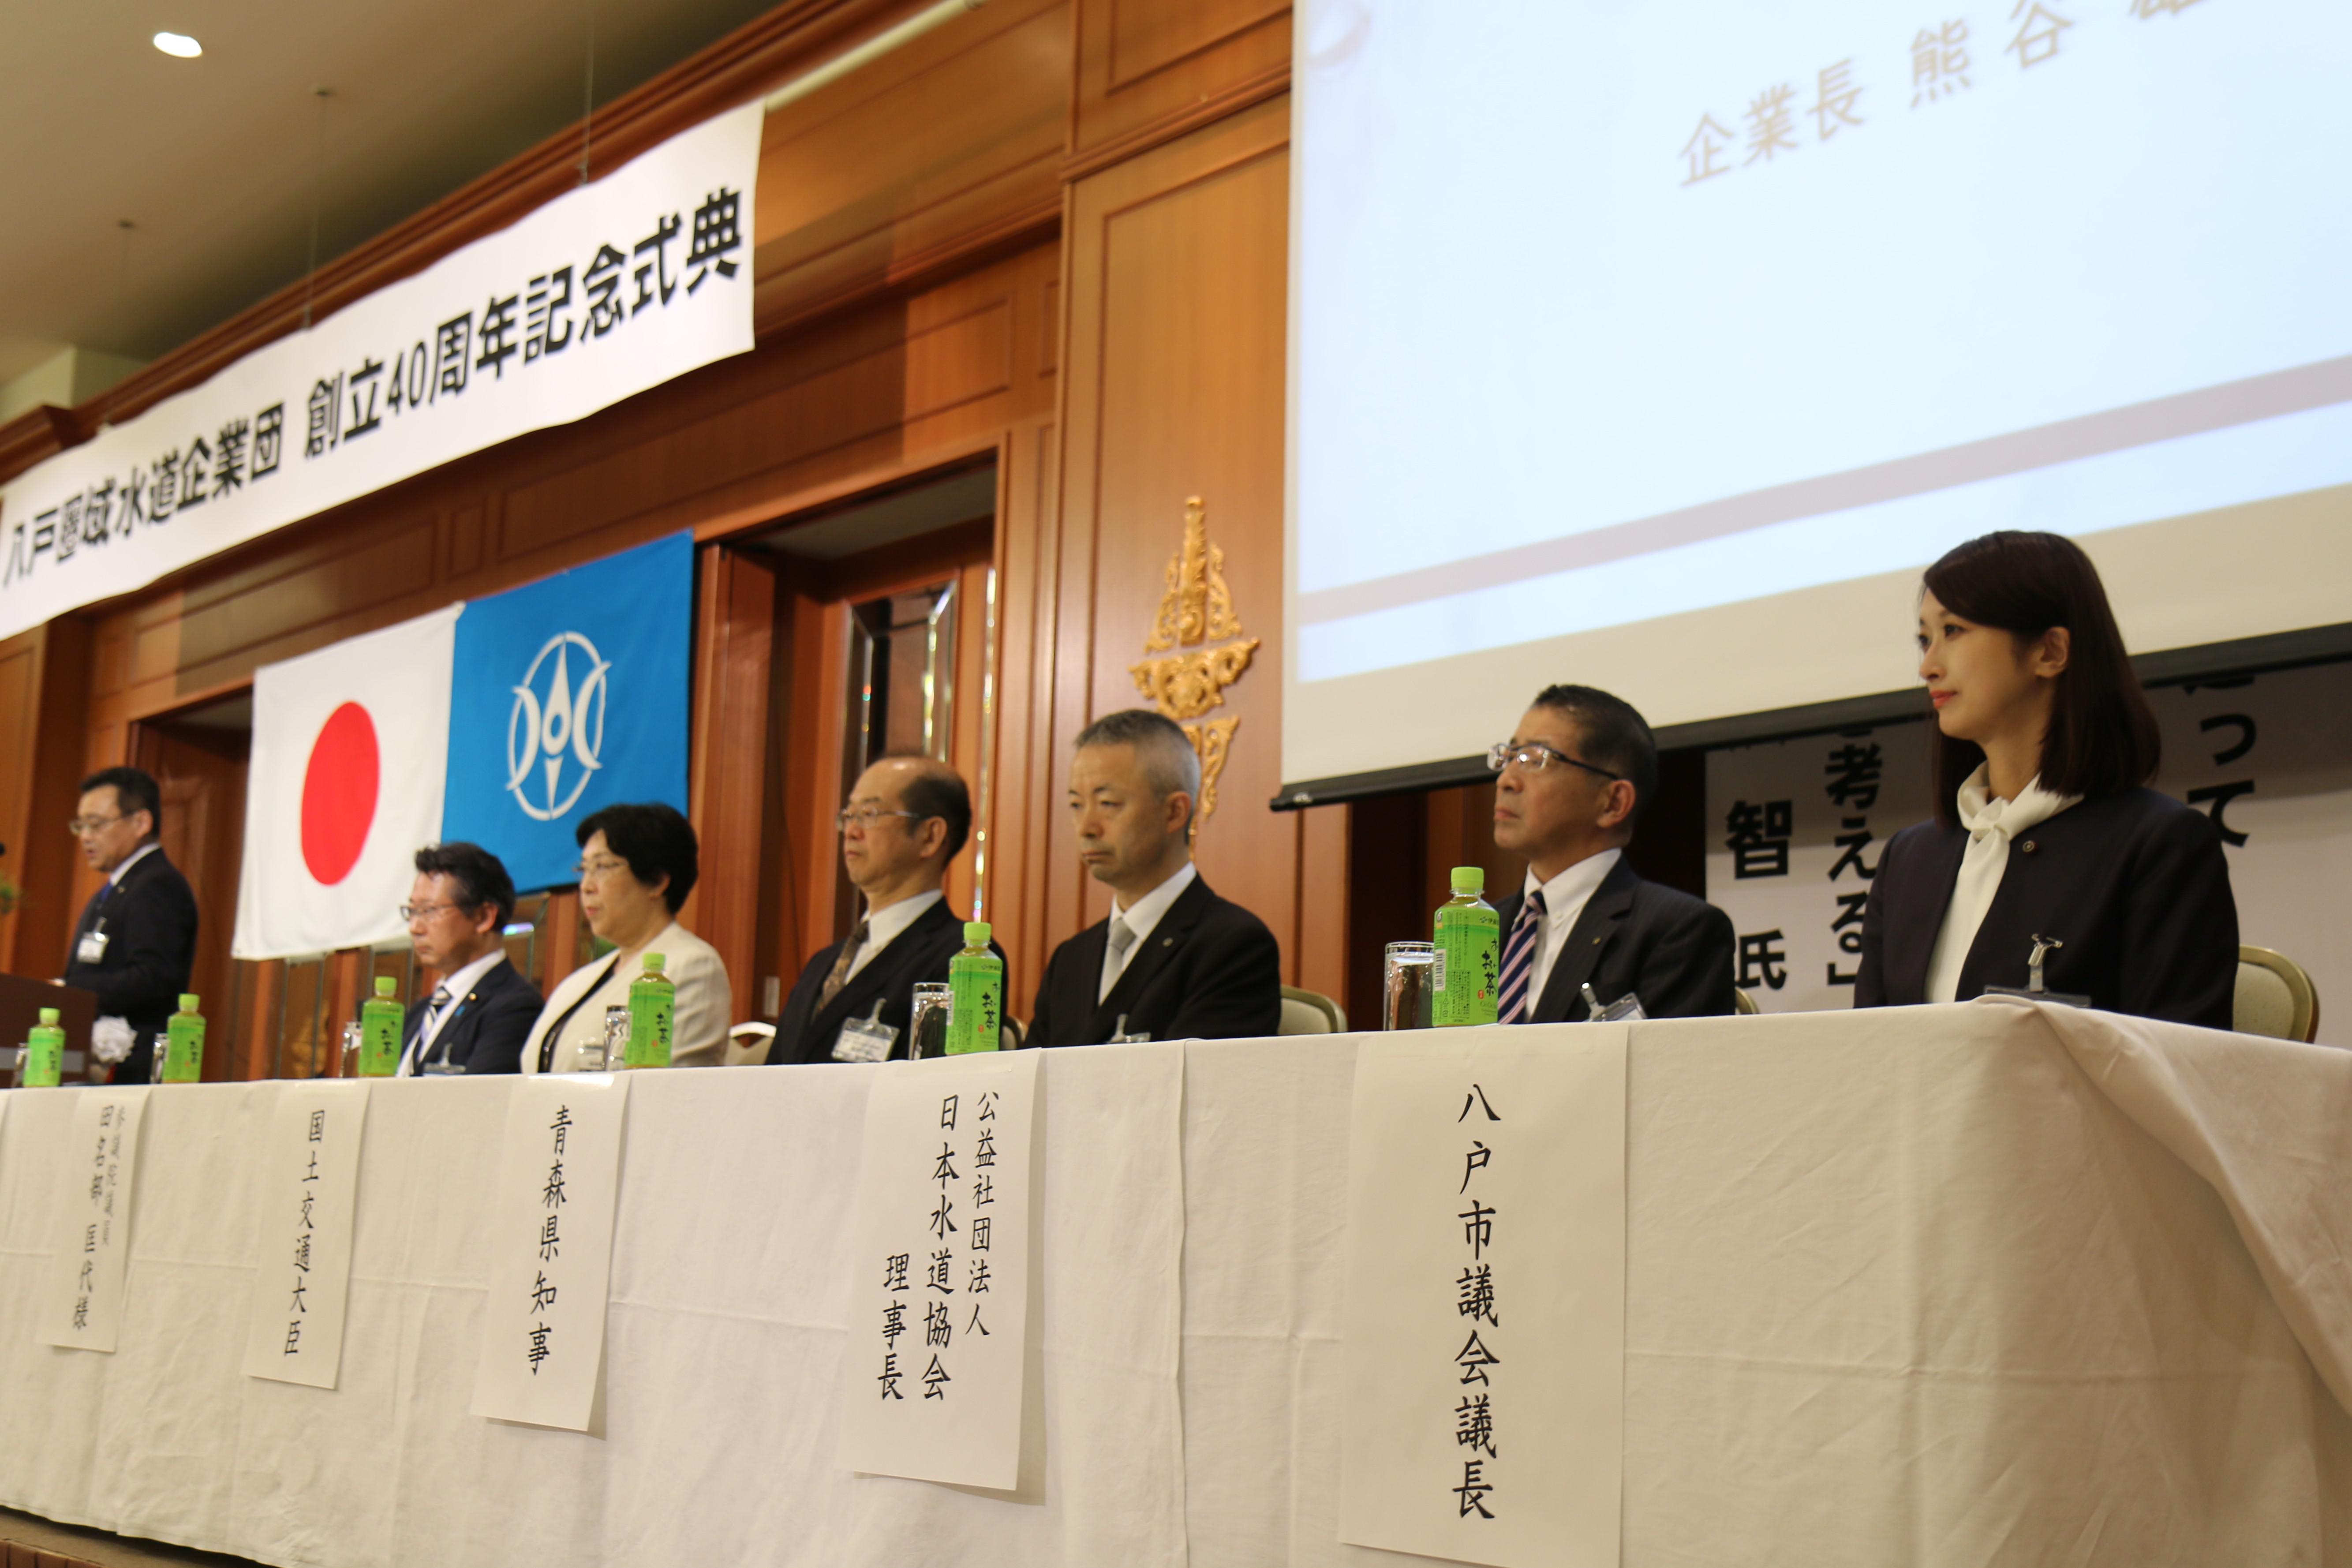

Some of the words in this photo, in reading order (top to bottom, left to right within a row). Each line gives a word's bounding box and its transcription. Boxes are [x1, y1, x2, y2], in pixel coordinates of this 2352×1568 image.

[1679, 57, 1865, 187] 企業長
[304, 187, 743, 459] 創立40周年記念式典
[1825, 727, 1882, 985] 考える」
[2185, 674, 2256, 848] って
[284, 1109, 325, 1357] 国土交通大臣
[527, 1104, 573, 1377] 青森県知事
[877, 1253, 910, 1401] 理事長
[920, 1094, 961, 1401] 日本水道協会
[965, 1091, 999, 1336] 公益社団法人
[1451, 1083, 1502, 1519] 八戸市議会議長
